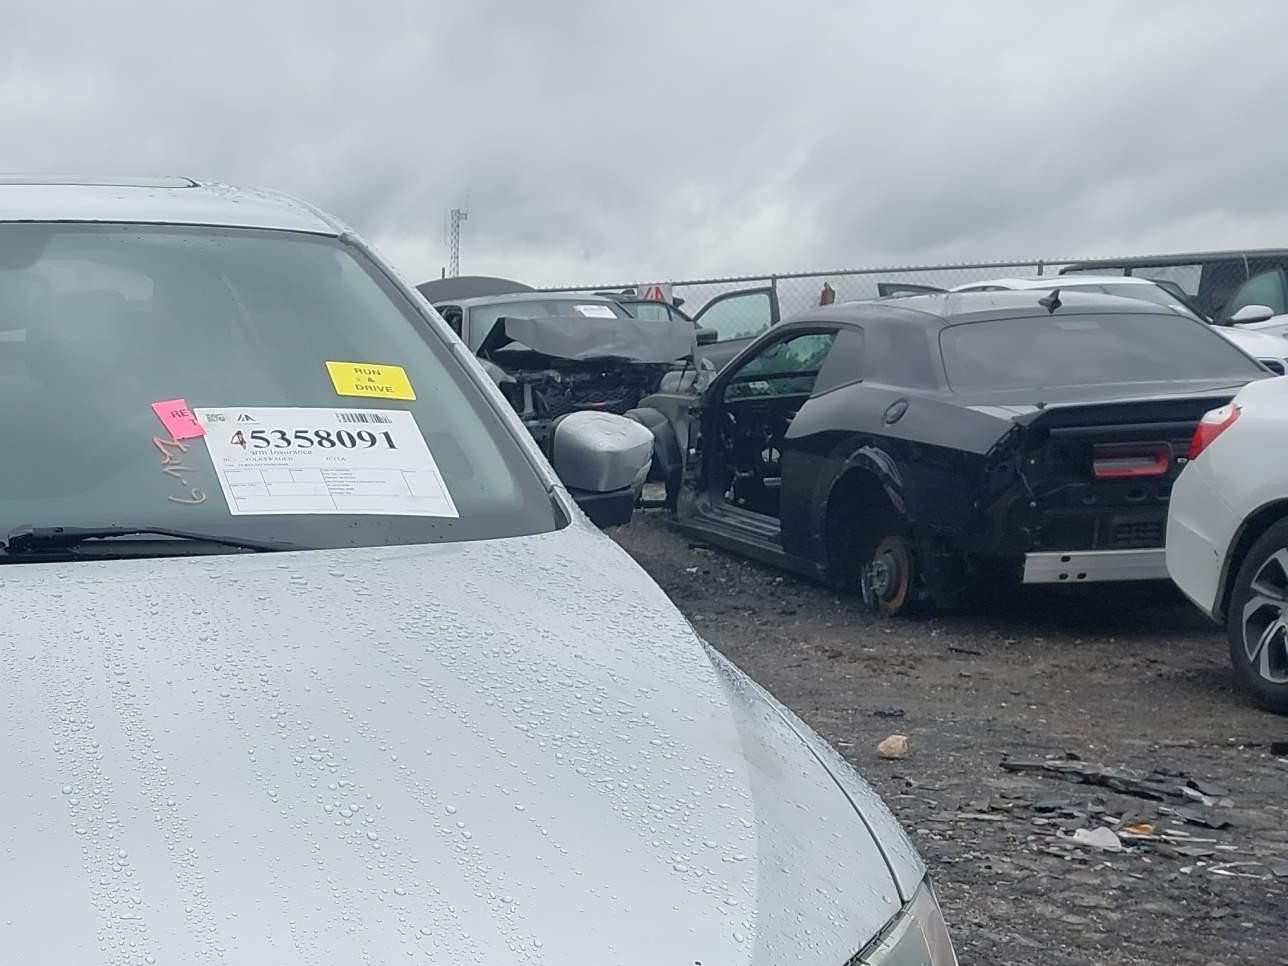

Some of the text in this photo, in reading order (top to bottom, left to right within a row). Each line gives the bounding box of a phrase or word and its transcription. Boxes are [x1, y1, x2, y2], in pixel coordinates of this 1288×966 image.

[353, 367, 382, 376] RUN
[354, 384, 394, 394] DRIVE
[230, 429, 400, 450] 45358091
